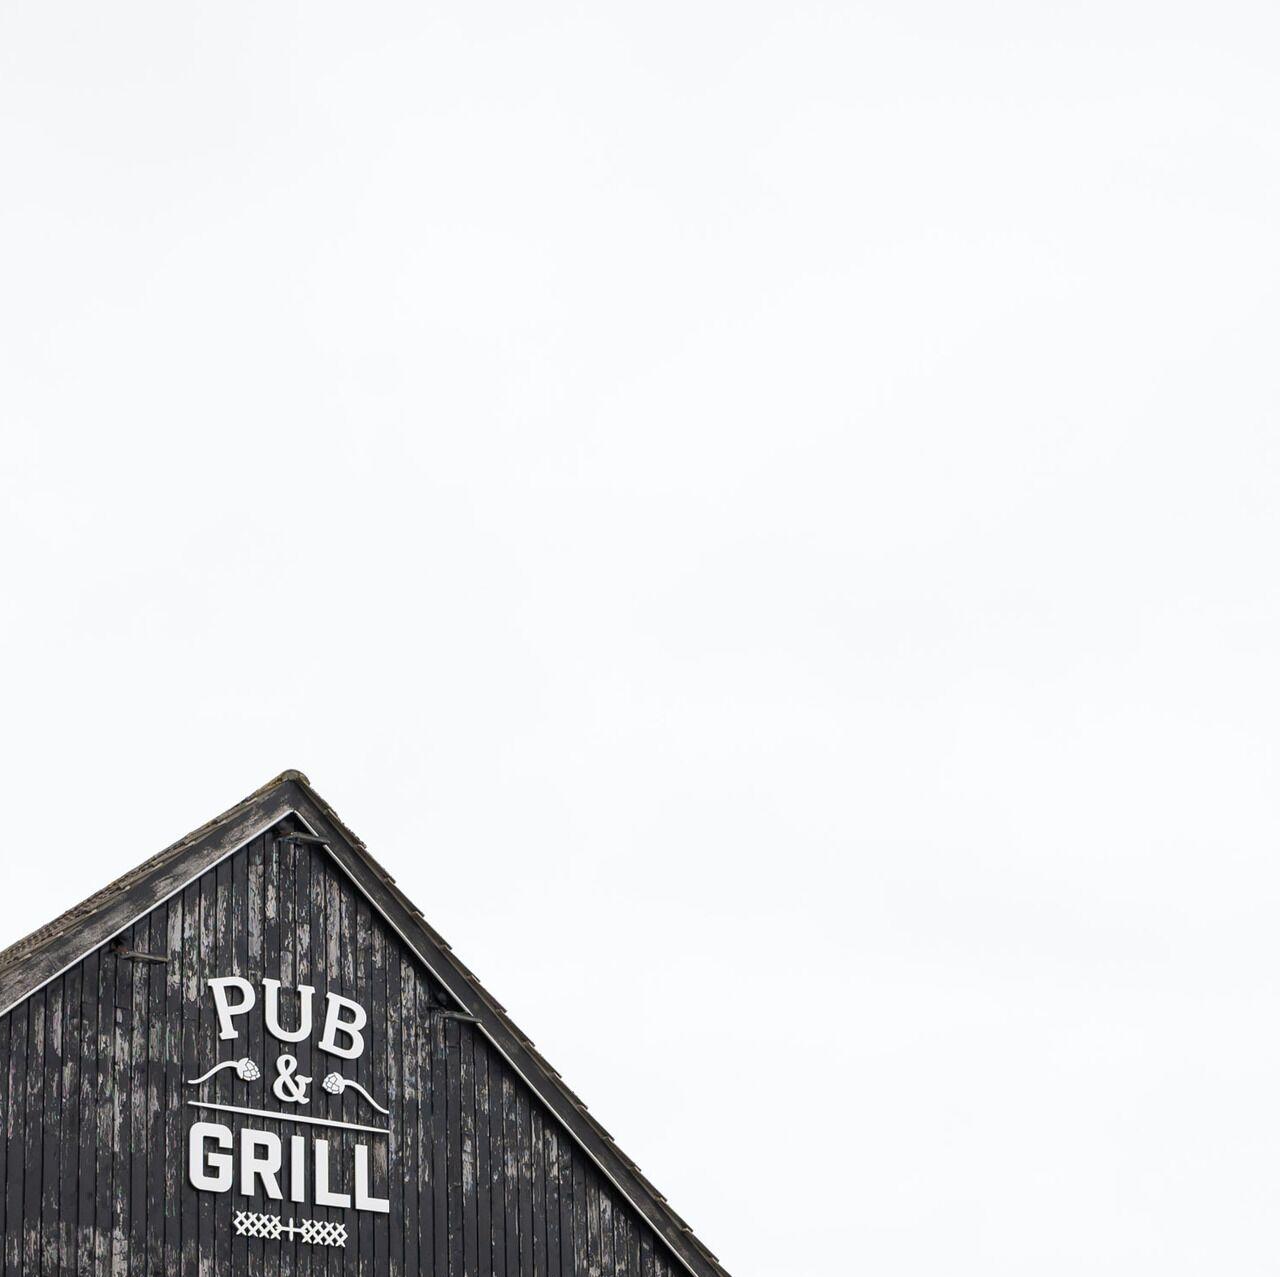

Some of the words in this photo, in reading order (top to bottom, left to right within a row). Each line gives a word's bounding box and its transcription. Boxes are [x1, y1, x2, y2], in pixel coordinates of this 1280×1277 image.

[208, 976, 367, 1060] PUB
[272, 1054, 312, 1105] &
[189, 1121, 390, 1213] GRILL
